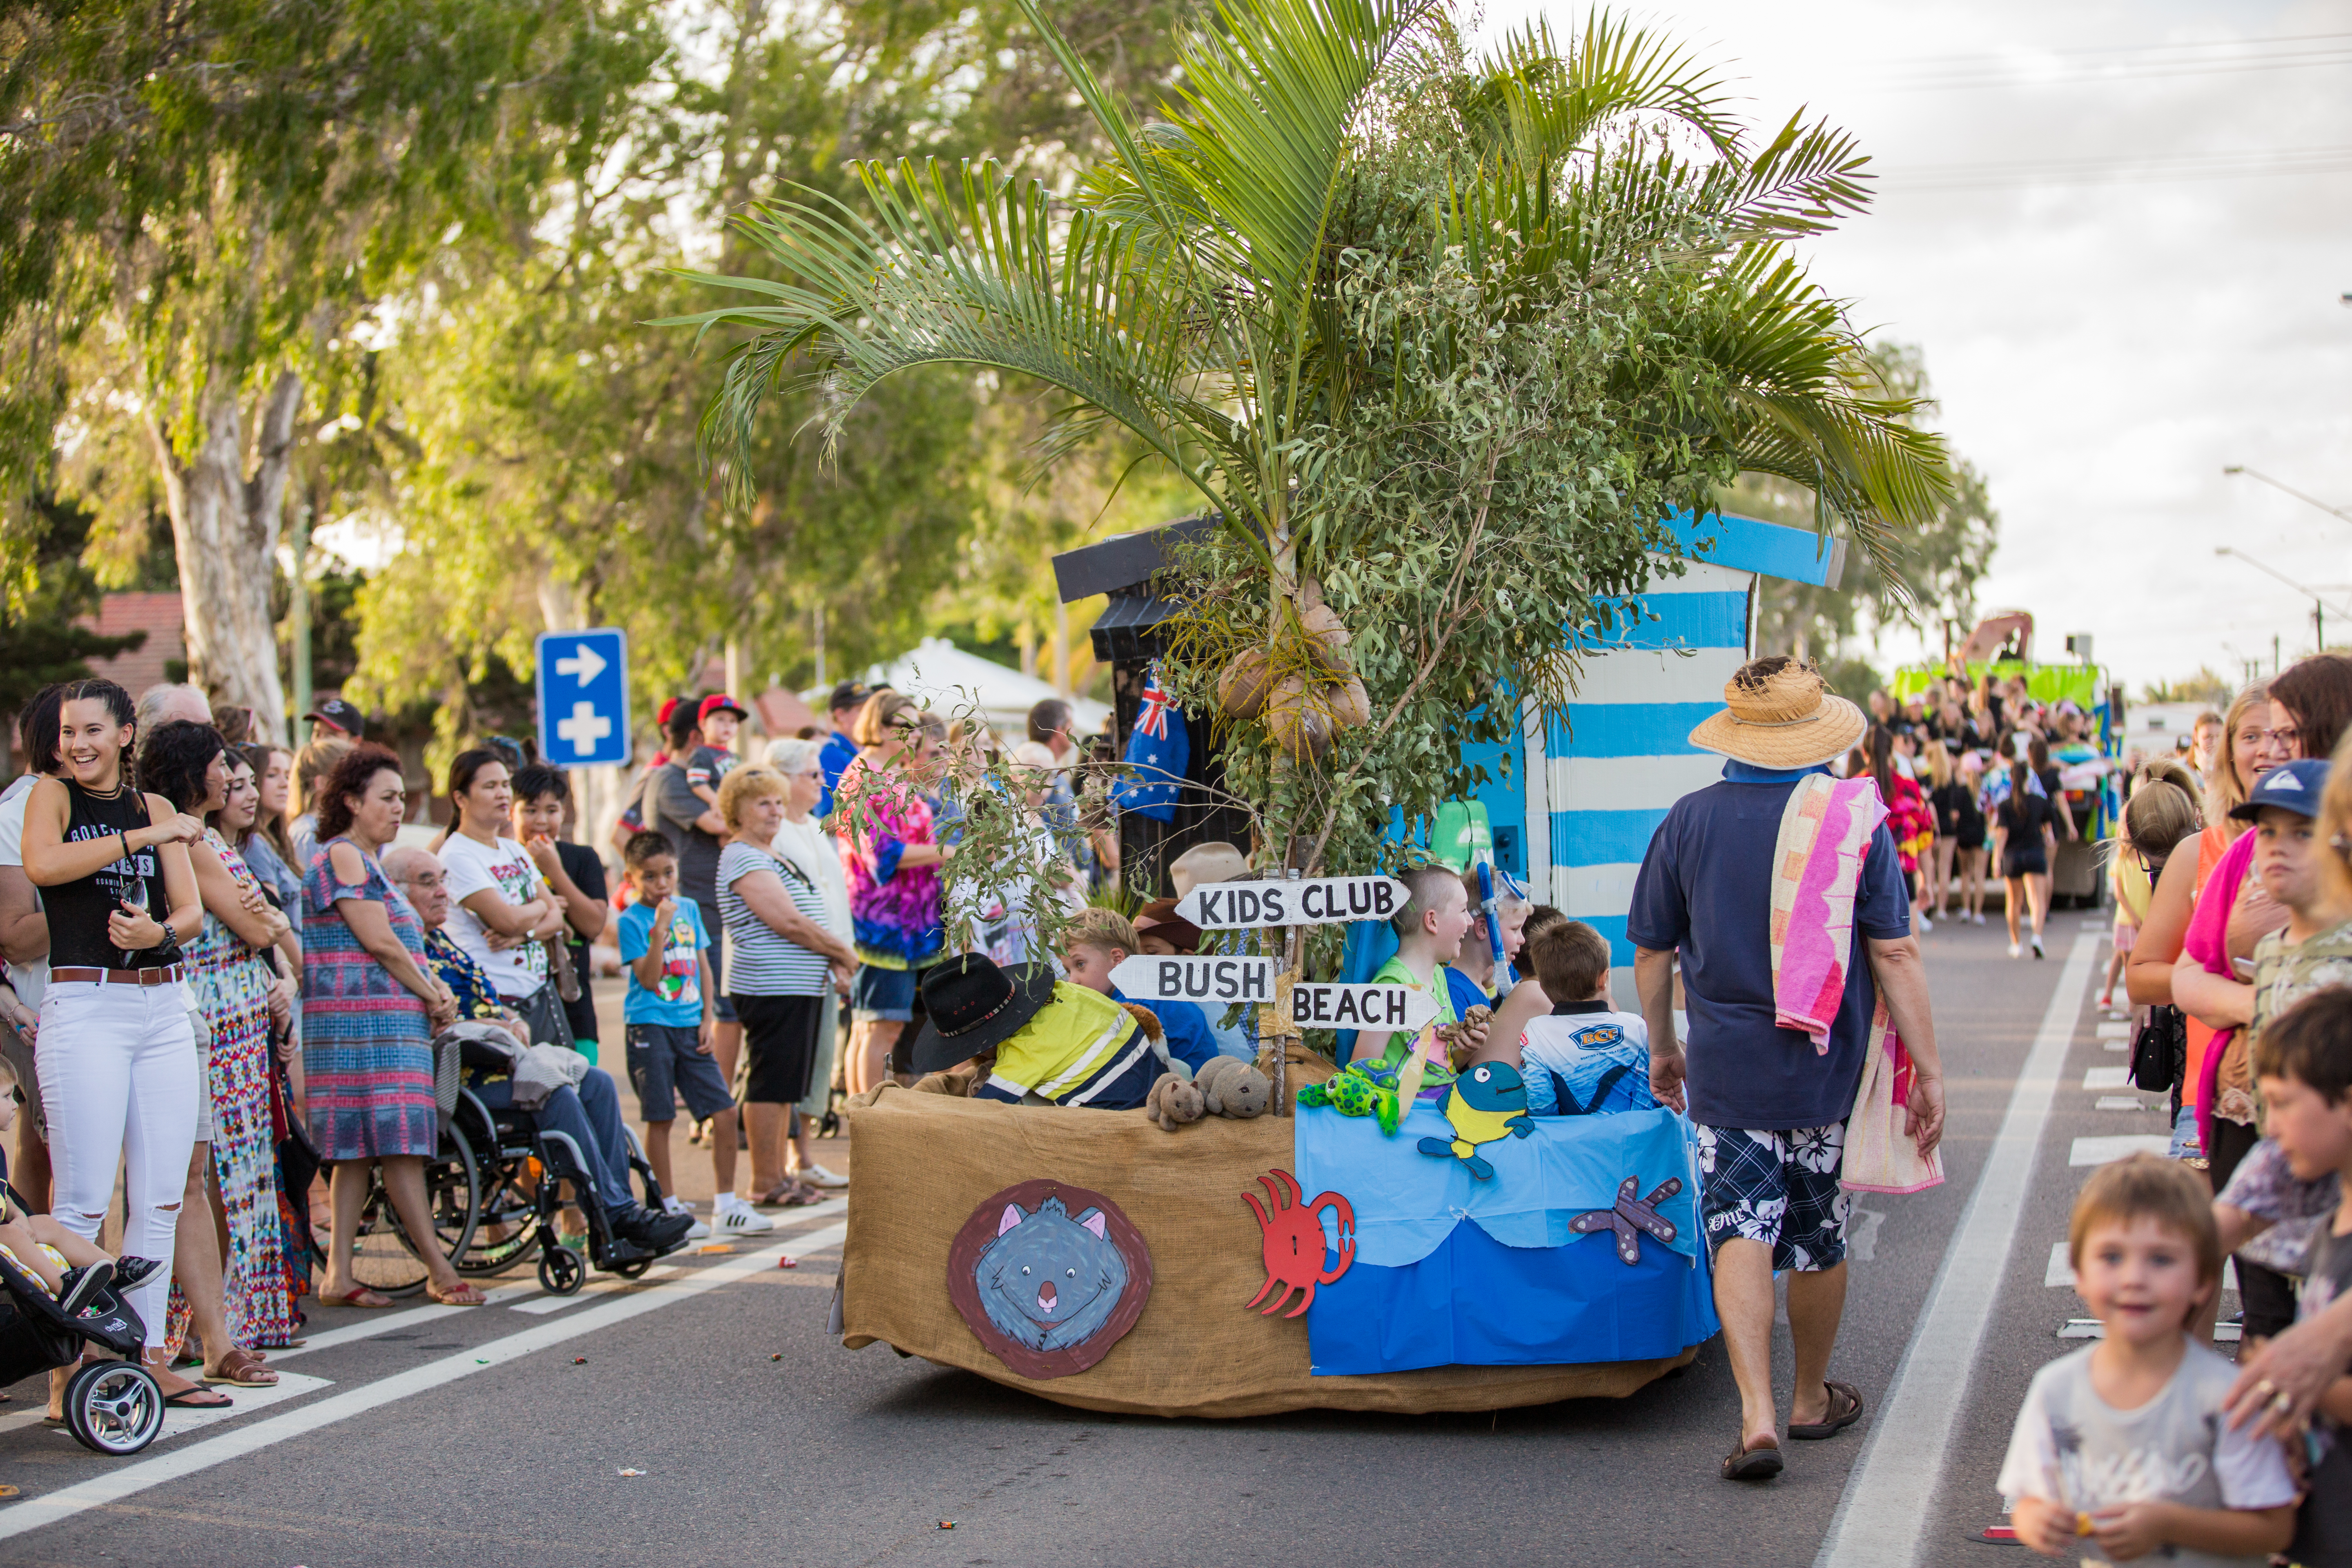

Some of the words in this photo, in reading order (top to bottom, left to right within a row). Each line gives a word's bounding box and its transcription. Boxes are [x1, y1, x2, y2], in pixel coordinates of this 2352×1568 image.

[96, 878, 121, 887] ROAMIN
[1199, 888, 1284, 924] KIDS
[1302, 882, 1394, 918] CLUB
[1158, 961, 1265, 998] BUSH
[1293, 987, 1405, 1025] BEACH
[1581, 1028, 1618, 1046] BCF
